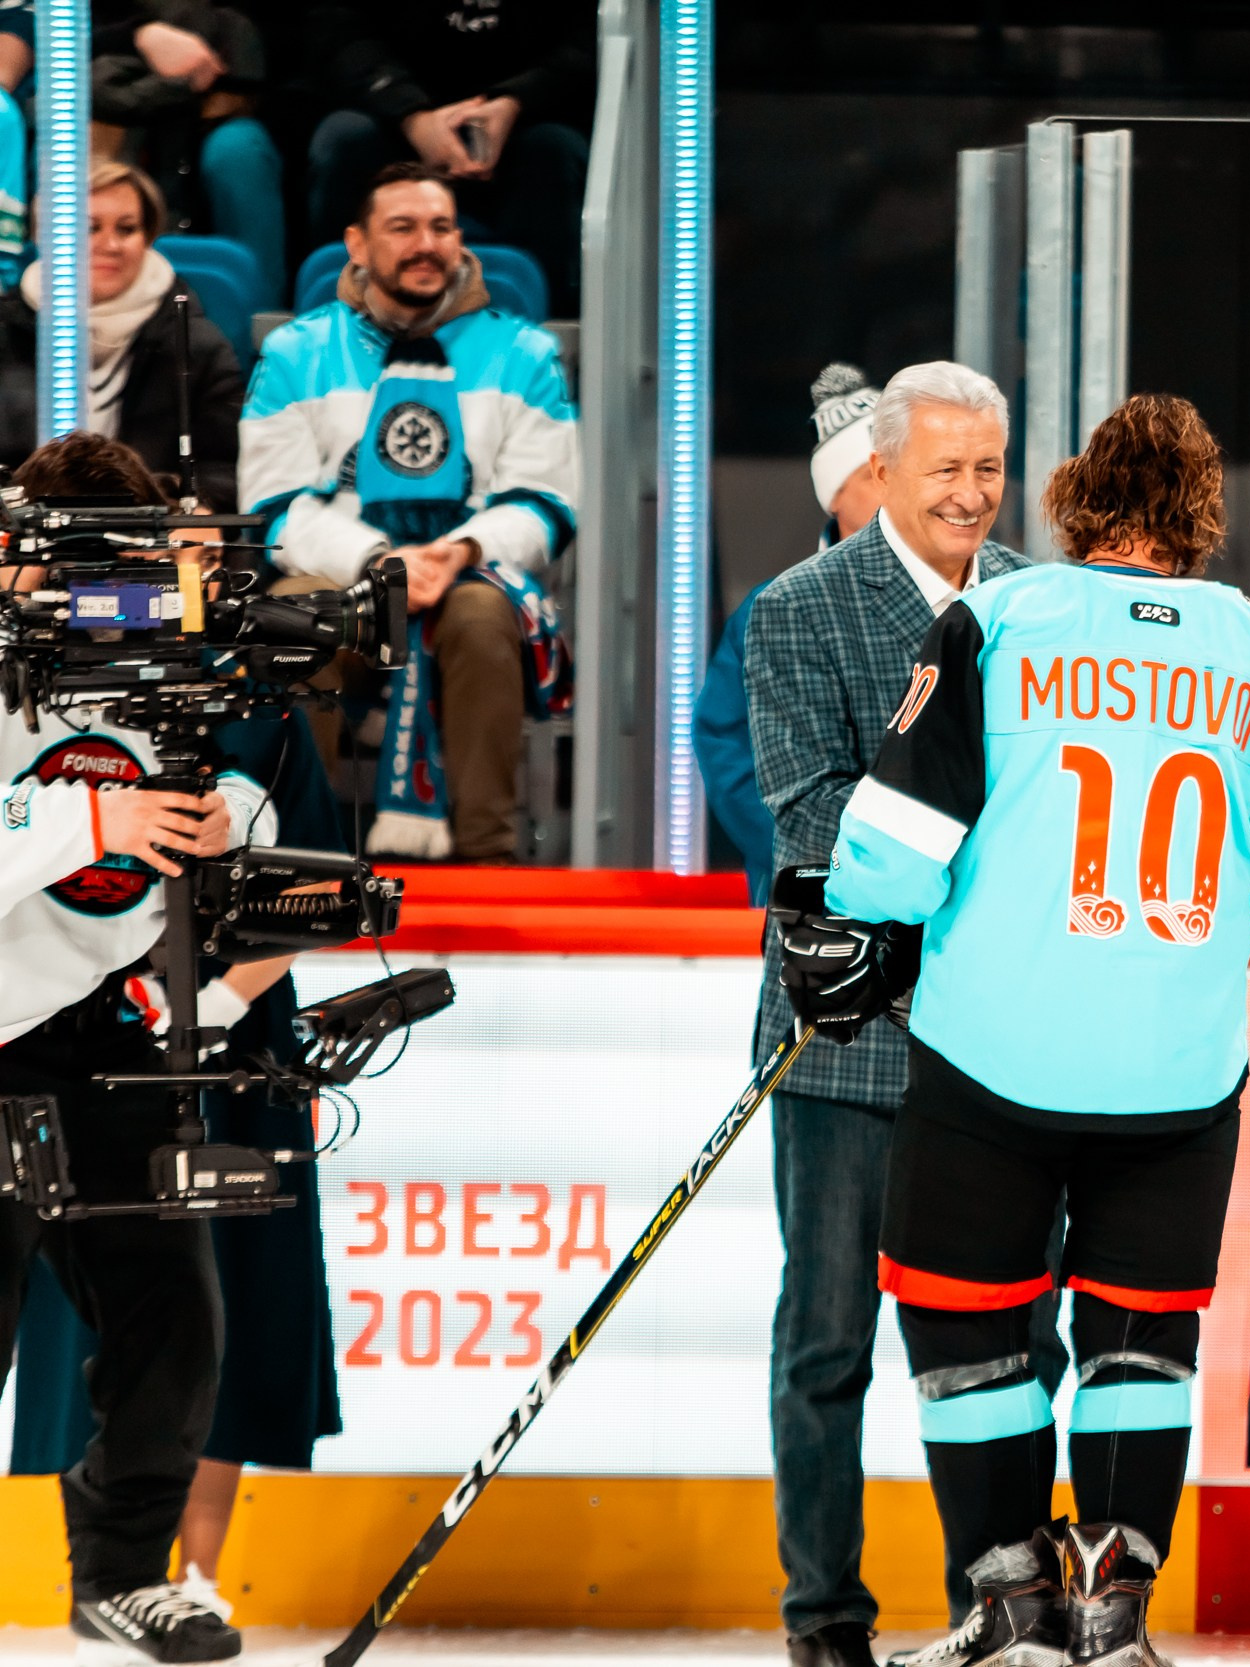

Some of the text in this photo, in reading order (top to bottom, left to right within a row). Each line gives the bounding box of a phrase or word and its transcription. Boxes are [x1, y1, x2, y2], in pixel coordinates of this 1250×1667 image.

[272, 655, 313, 663] FUJINON
[61, 754, 129, 776] FONBET
[1057, 743, 1230, 946] 10
[346, 1182, 611, 1270] ЗВЕЗД
[632, 1187, 684, 1261] SUPER
[345, 1290, 543, 1366] 2023
[442, 1367, 560, 1528] CCM
